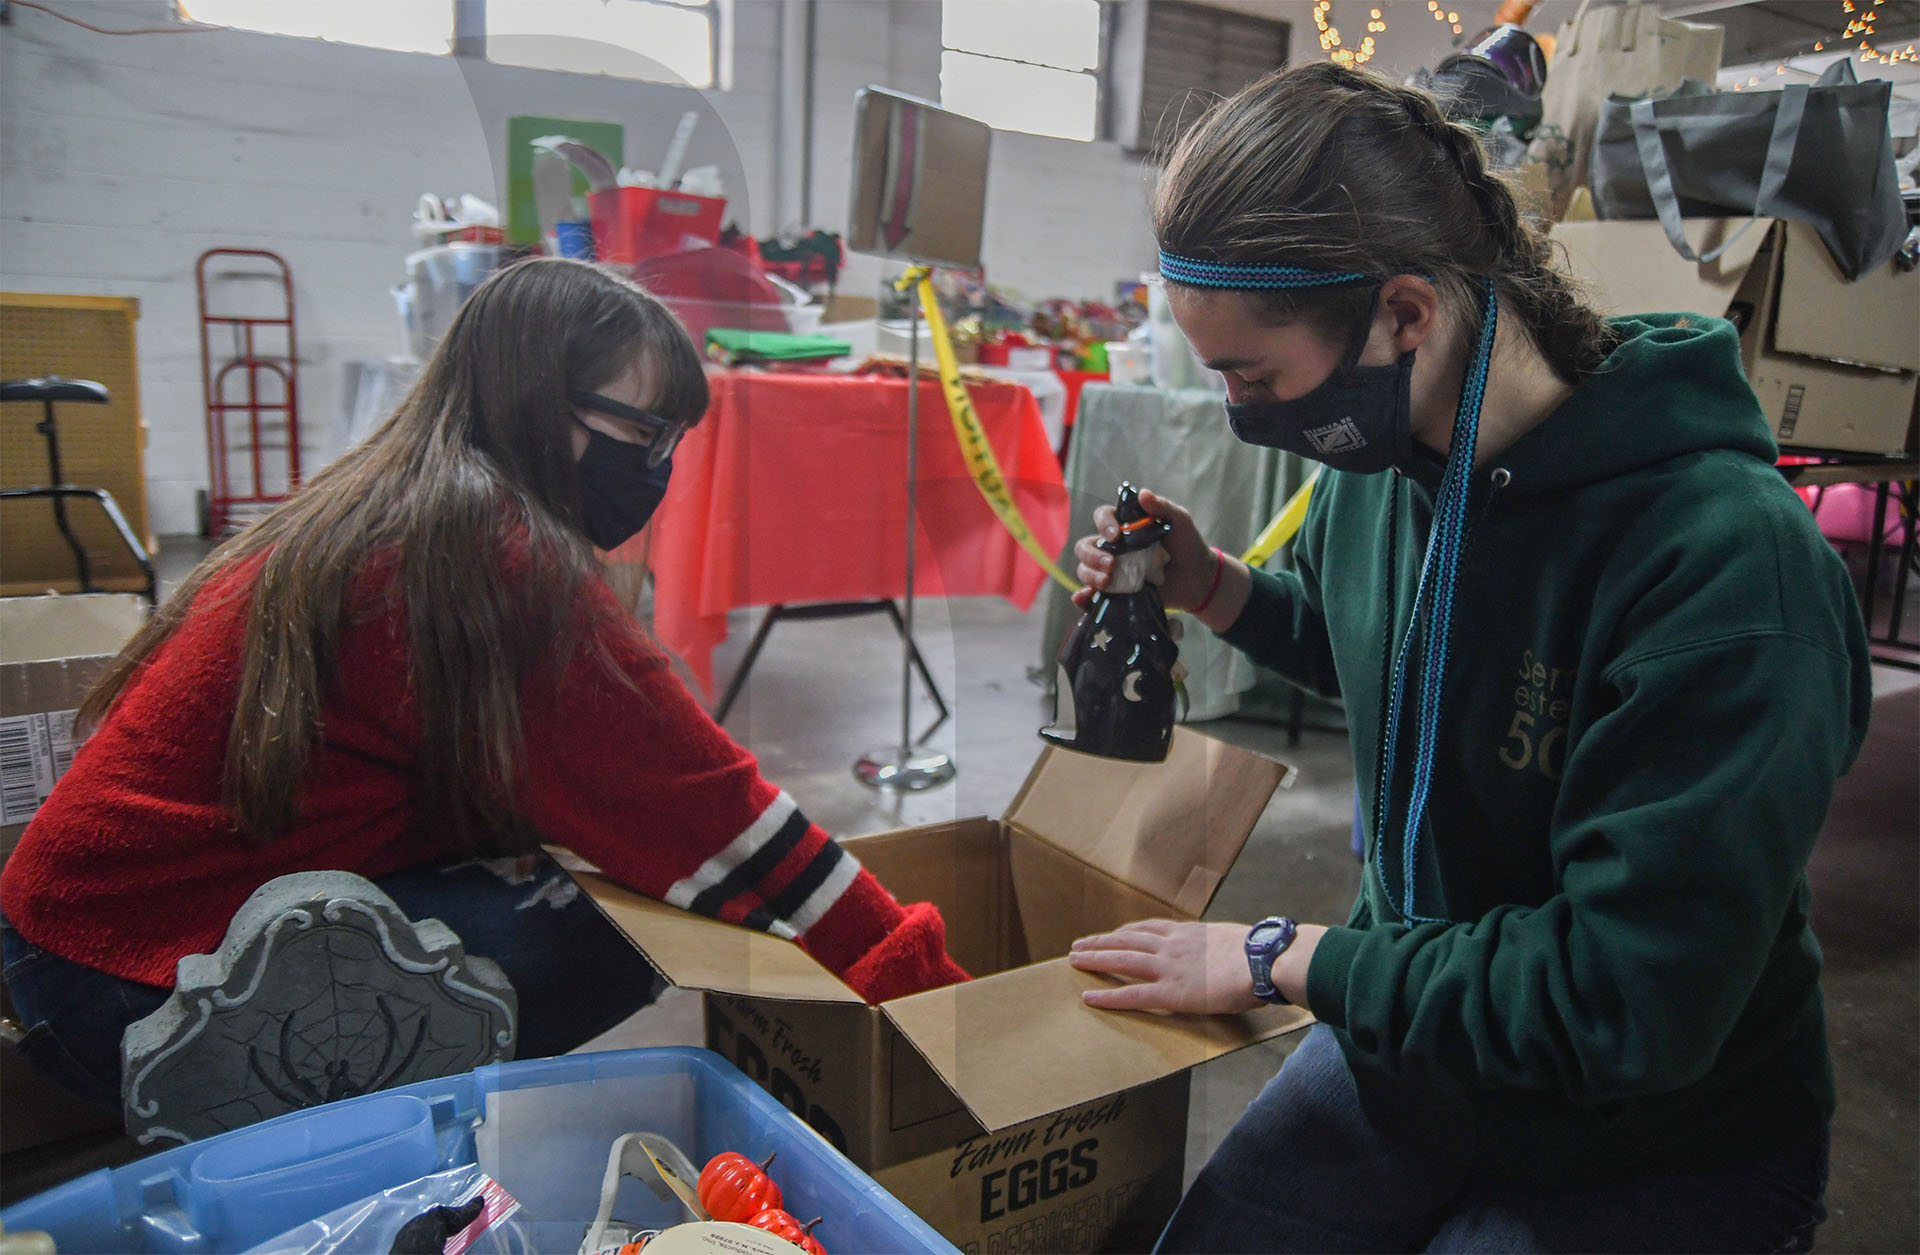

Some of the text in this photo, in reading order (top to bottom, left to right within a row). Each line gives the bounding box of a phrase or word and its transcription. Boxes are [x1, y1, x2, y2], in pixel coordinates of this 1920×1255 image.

[951, 1093, 1128, 1179] Farm Fresh
[980, 1137, 1099, 1225] EGGS
